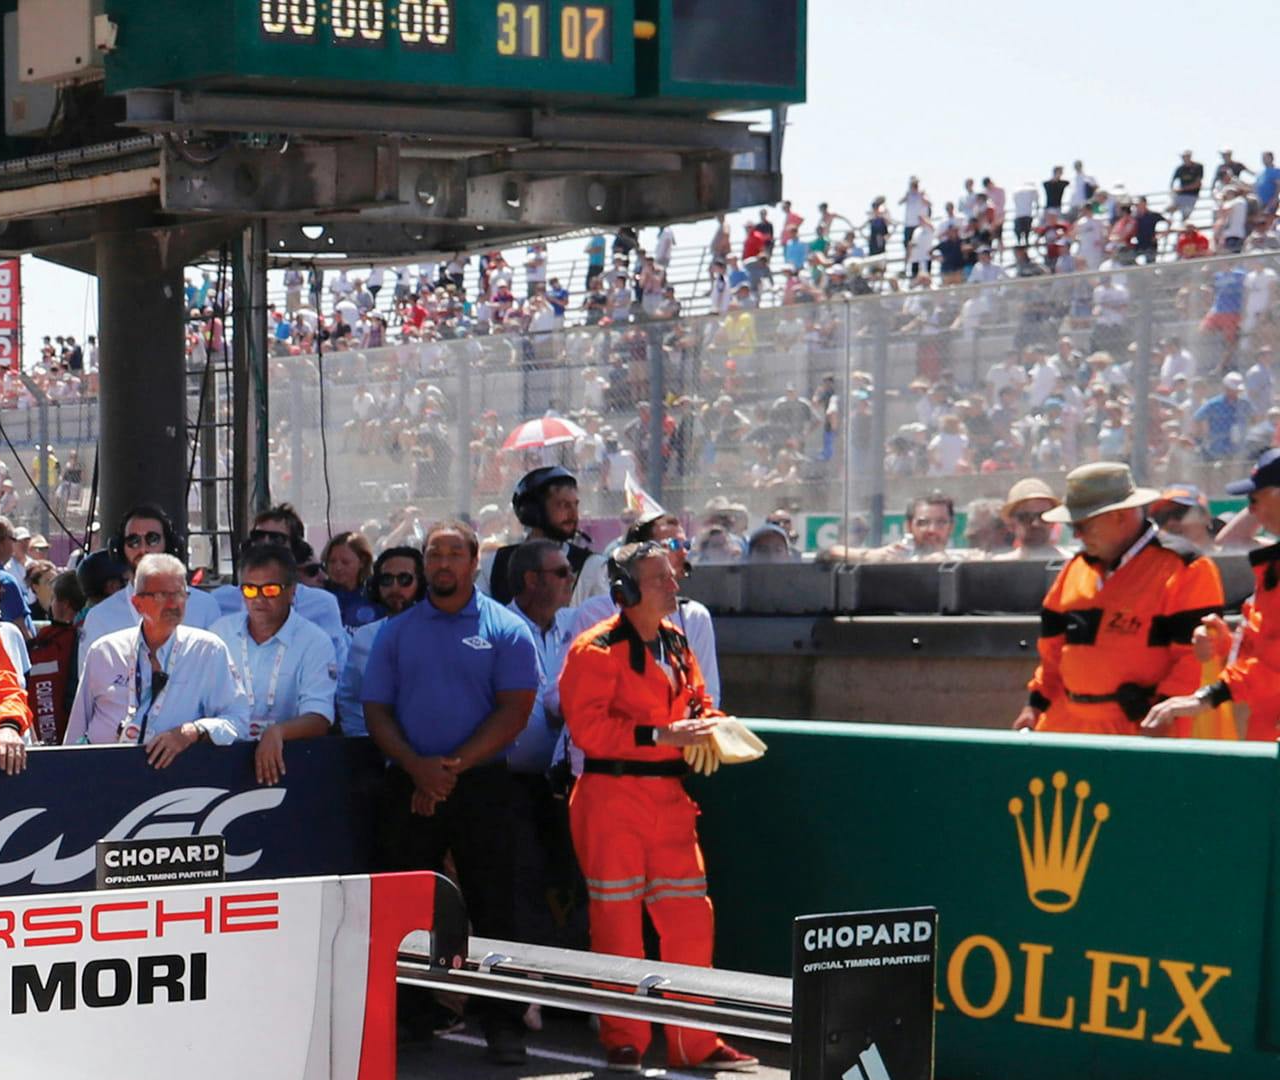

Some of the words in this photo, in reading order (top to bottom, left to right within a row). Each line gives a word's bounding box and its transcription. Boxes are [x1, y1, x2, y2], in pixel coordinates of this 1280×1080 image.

[497, 3, 540, 57] 31
[560, 6, 606, 60] 07
[104, 844, 220, 868] CHOPARD
[105, 874, 146, 885] OFFICIAL
[146, 872, 177, 882] TIMING
[178, 869, 219, 880] PARTNER
[803, 921, 933, 951] CHOPARD
[803, 960, 844, 973] OFFICIAL
[844, 957, 881, 969] TIMING
[882, 954, 931, 966] PARTNER
[10, 951, 208, 1015] MORI
[932, 934, 1233, 1054] OLEX
